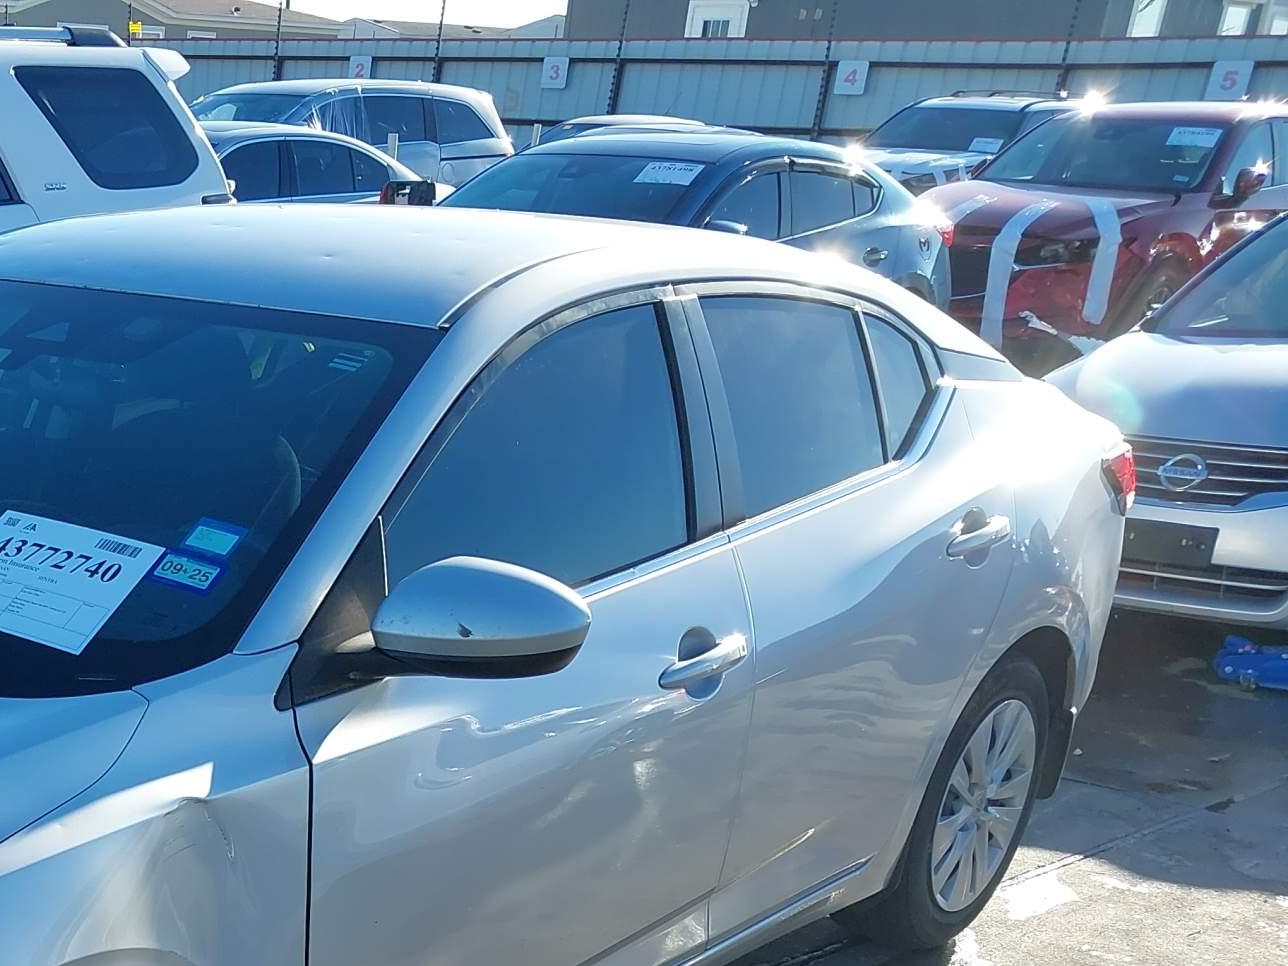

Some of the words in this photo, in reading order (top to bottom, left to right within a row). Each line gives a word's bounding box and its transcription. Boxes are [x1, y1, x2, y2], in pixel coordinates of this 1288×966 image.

[354, 63, 365, 78] 2
[549, 64, 560, 80] 3
[843, 68, 857, 86] 4
[1219, 70, 1240, 91] 5
[8, 559, 40, 573] Insurance
[161, 560, 184, 575] 09
[188, 568, 213, 583] 25
